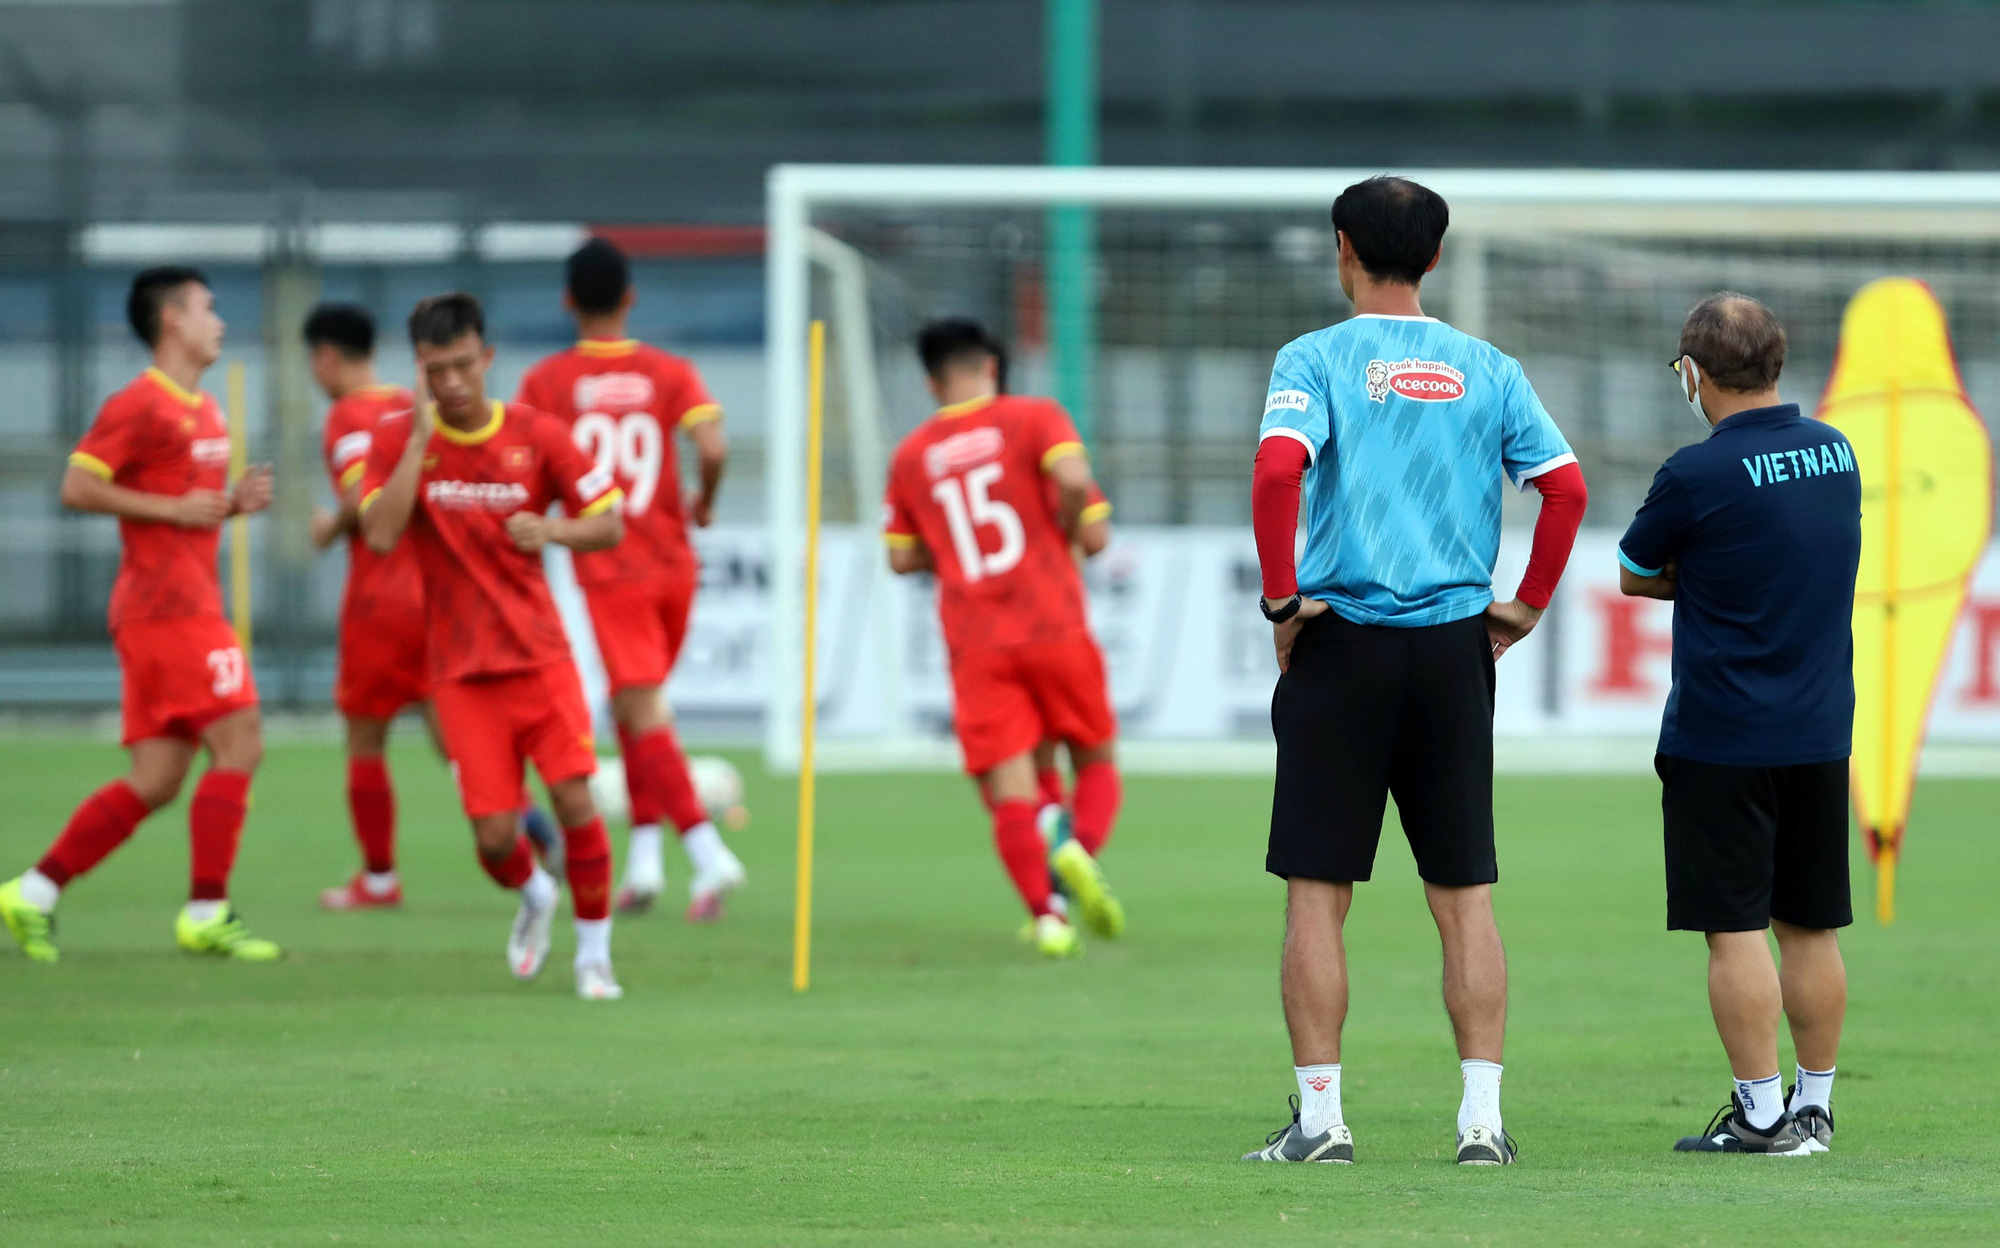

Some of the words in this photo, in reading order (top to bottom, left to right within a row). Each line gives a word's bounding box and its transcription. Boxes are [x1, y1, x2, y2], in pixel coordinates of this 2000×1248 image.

[1389, 360, 1412, 371] Cook
[1415, 360, 1463, 380] happiness
[1741, 441, 1855, 488] VIETNAM
[931, 460, 1026, 583] 15
